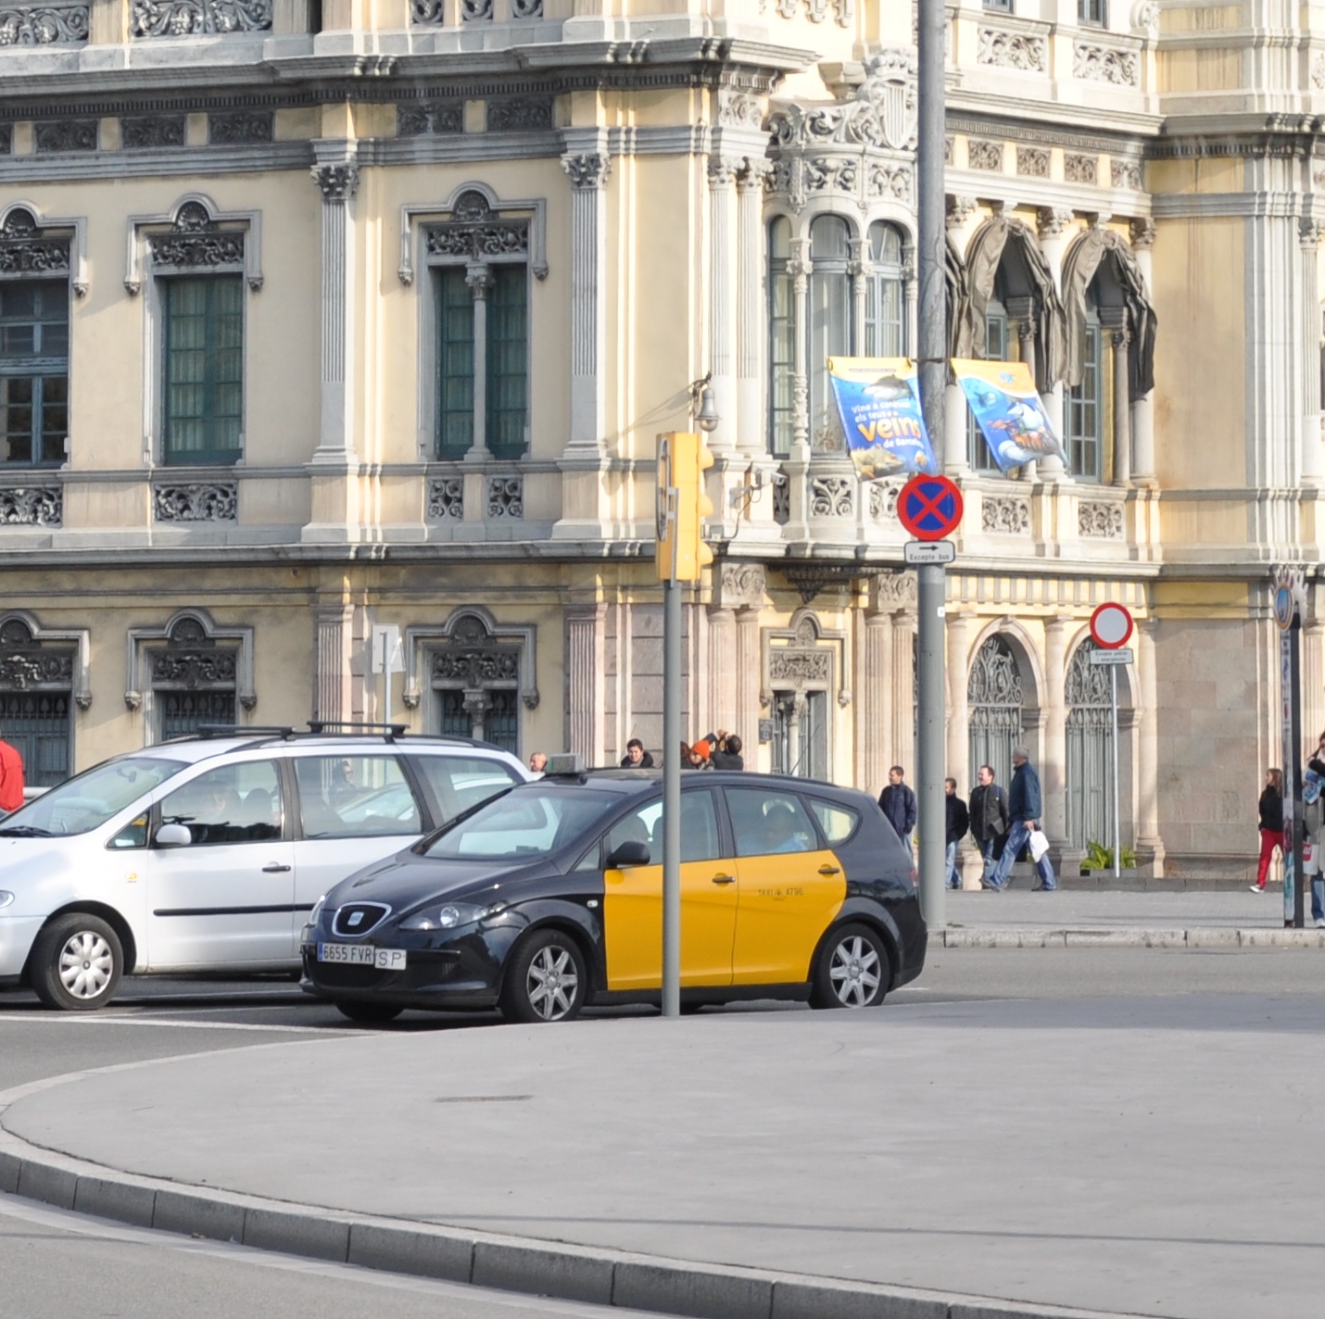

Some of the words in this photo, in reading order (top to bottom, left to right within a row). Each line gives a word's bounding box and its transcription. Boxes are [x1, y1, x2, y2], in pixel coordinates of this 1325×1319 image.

[323, 945, 348, 961] 6655
[351, 947, 372, 963] FVR
[378, 951, 403, 967] SP
